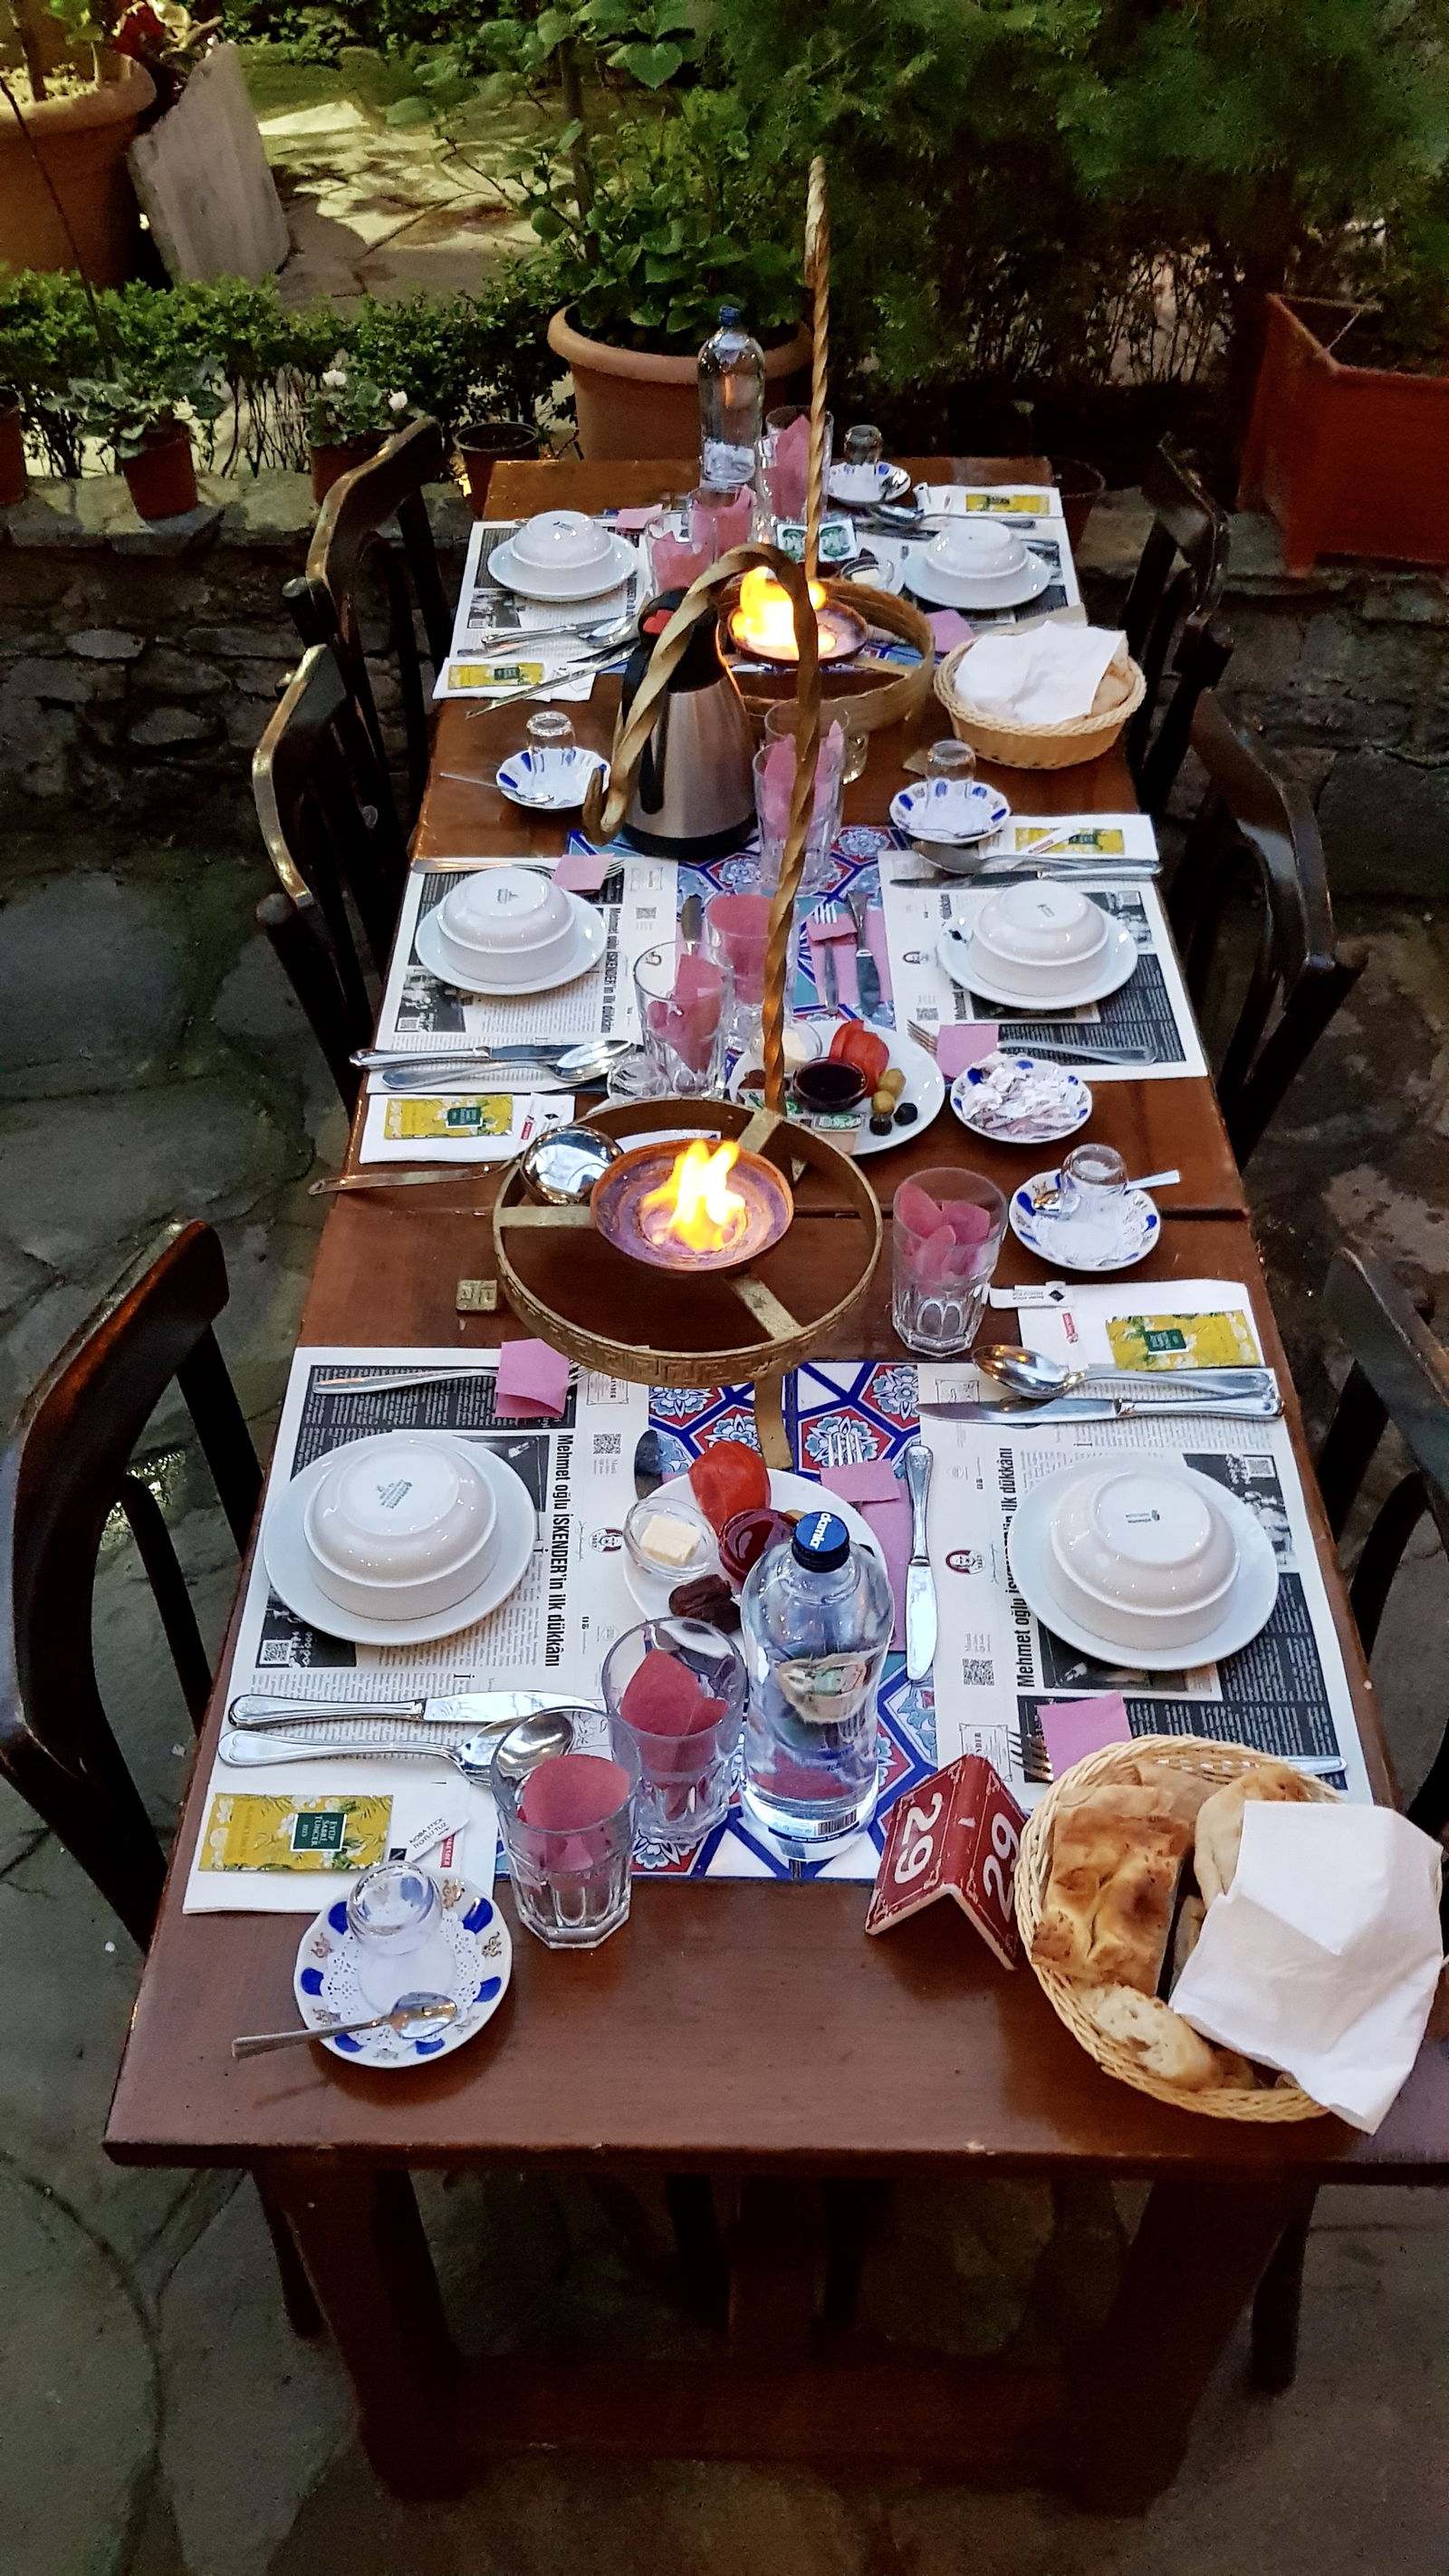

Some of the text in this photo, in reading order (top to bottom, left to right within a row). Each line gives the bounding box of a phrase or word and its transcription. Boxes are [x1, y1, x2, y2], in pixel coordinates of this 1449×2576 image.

[996, 1447, 1015, 1494] dükkânı
[1001, 1496, 1018, 1512] ilk
[545, 1434, 574, 1667] Mehmet oğlu İSKENDER'in ilk dükkânı
[809, 1513, 832, 1550] damla
[1011, 1596, 1031, 1626] oğlu
[1017, 1629, 1035, 1687] Mehmet
[895, 1793, 943, 1884] 29
[983, 1812, 1021, 1923] 29
